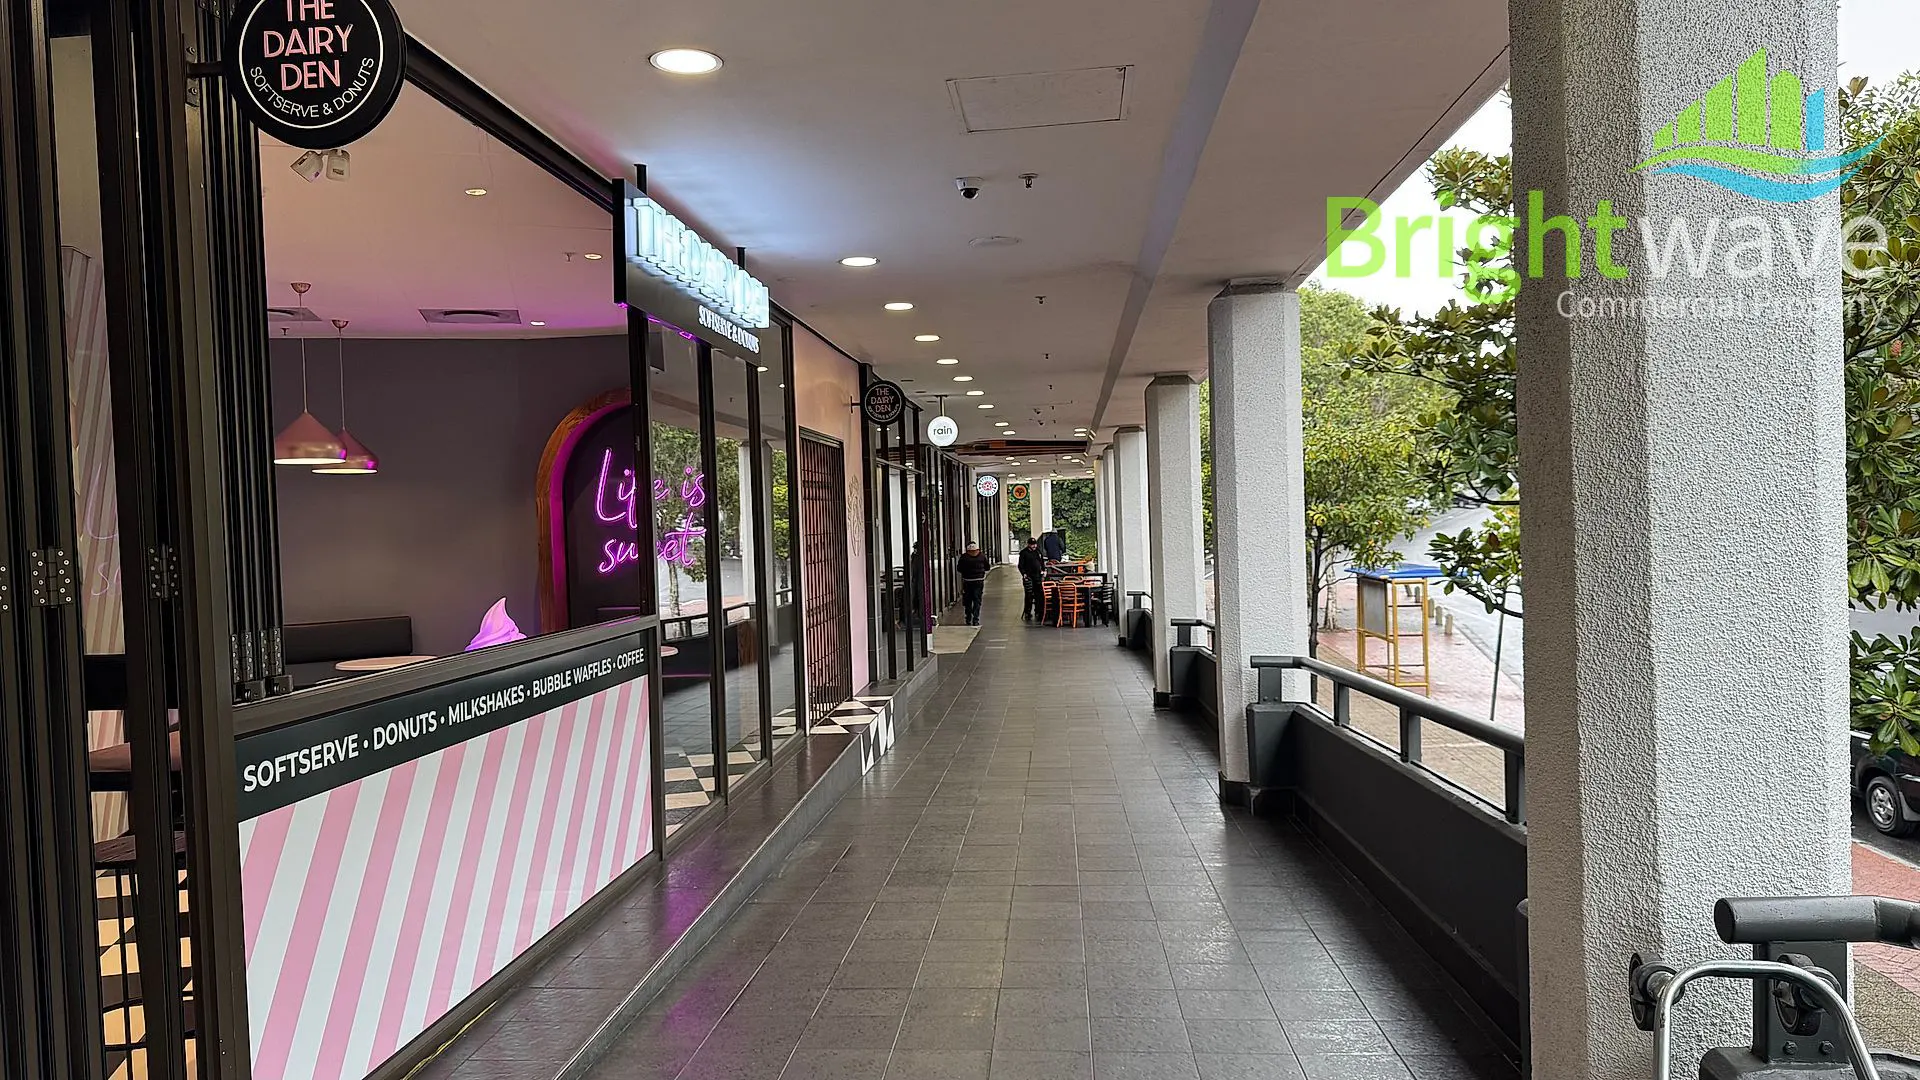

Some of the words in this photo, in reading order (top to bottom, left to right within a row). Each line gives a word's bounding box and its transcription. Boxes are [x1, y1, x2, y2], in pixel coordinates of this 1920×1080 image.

[286, 0, 335, 22] THE
[264, 24, 353, 58] DAIRY
[250, 66, 320, 118] SOFTSERVE
[322, 102, 334, 116] &
[333, 57, 375, 111] DONUTS
[280, 59, 342, 91] DEN
[698, 304, 733, 340] SOFTSERVE
[871, 396, 894, 404] DAIRY
[934, 426, 953, 435] rain
[681, 465, 706, 507] is
[598, 512, 707, 573] swet
[243, 732, 360, 793] SOFTSERVE
[373, 710, 438, 751] DONUTS
[448, 685, 526, 727] MILKSHAKES
[532, 674, 572, 698] BUBBLE
[572, 661, 613, 685] WAFFLES
[616, 647, 645, 670] COFFEE
